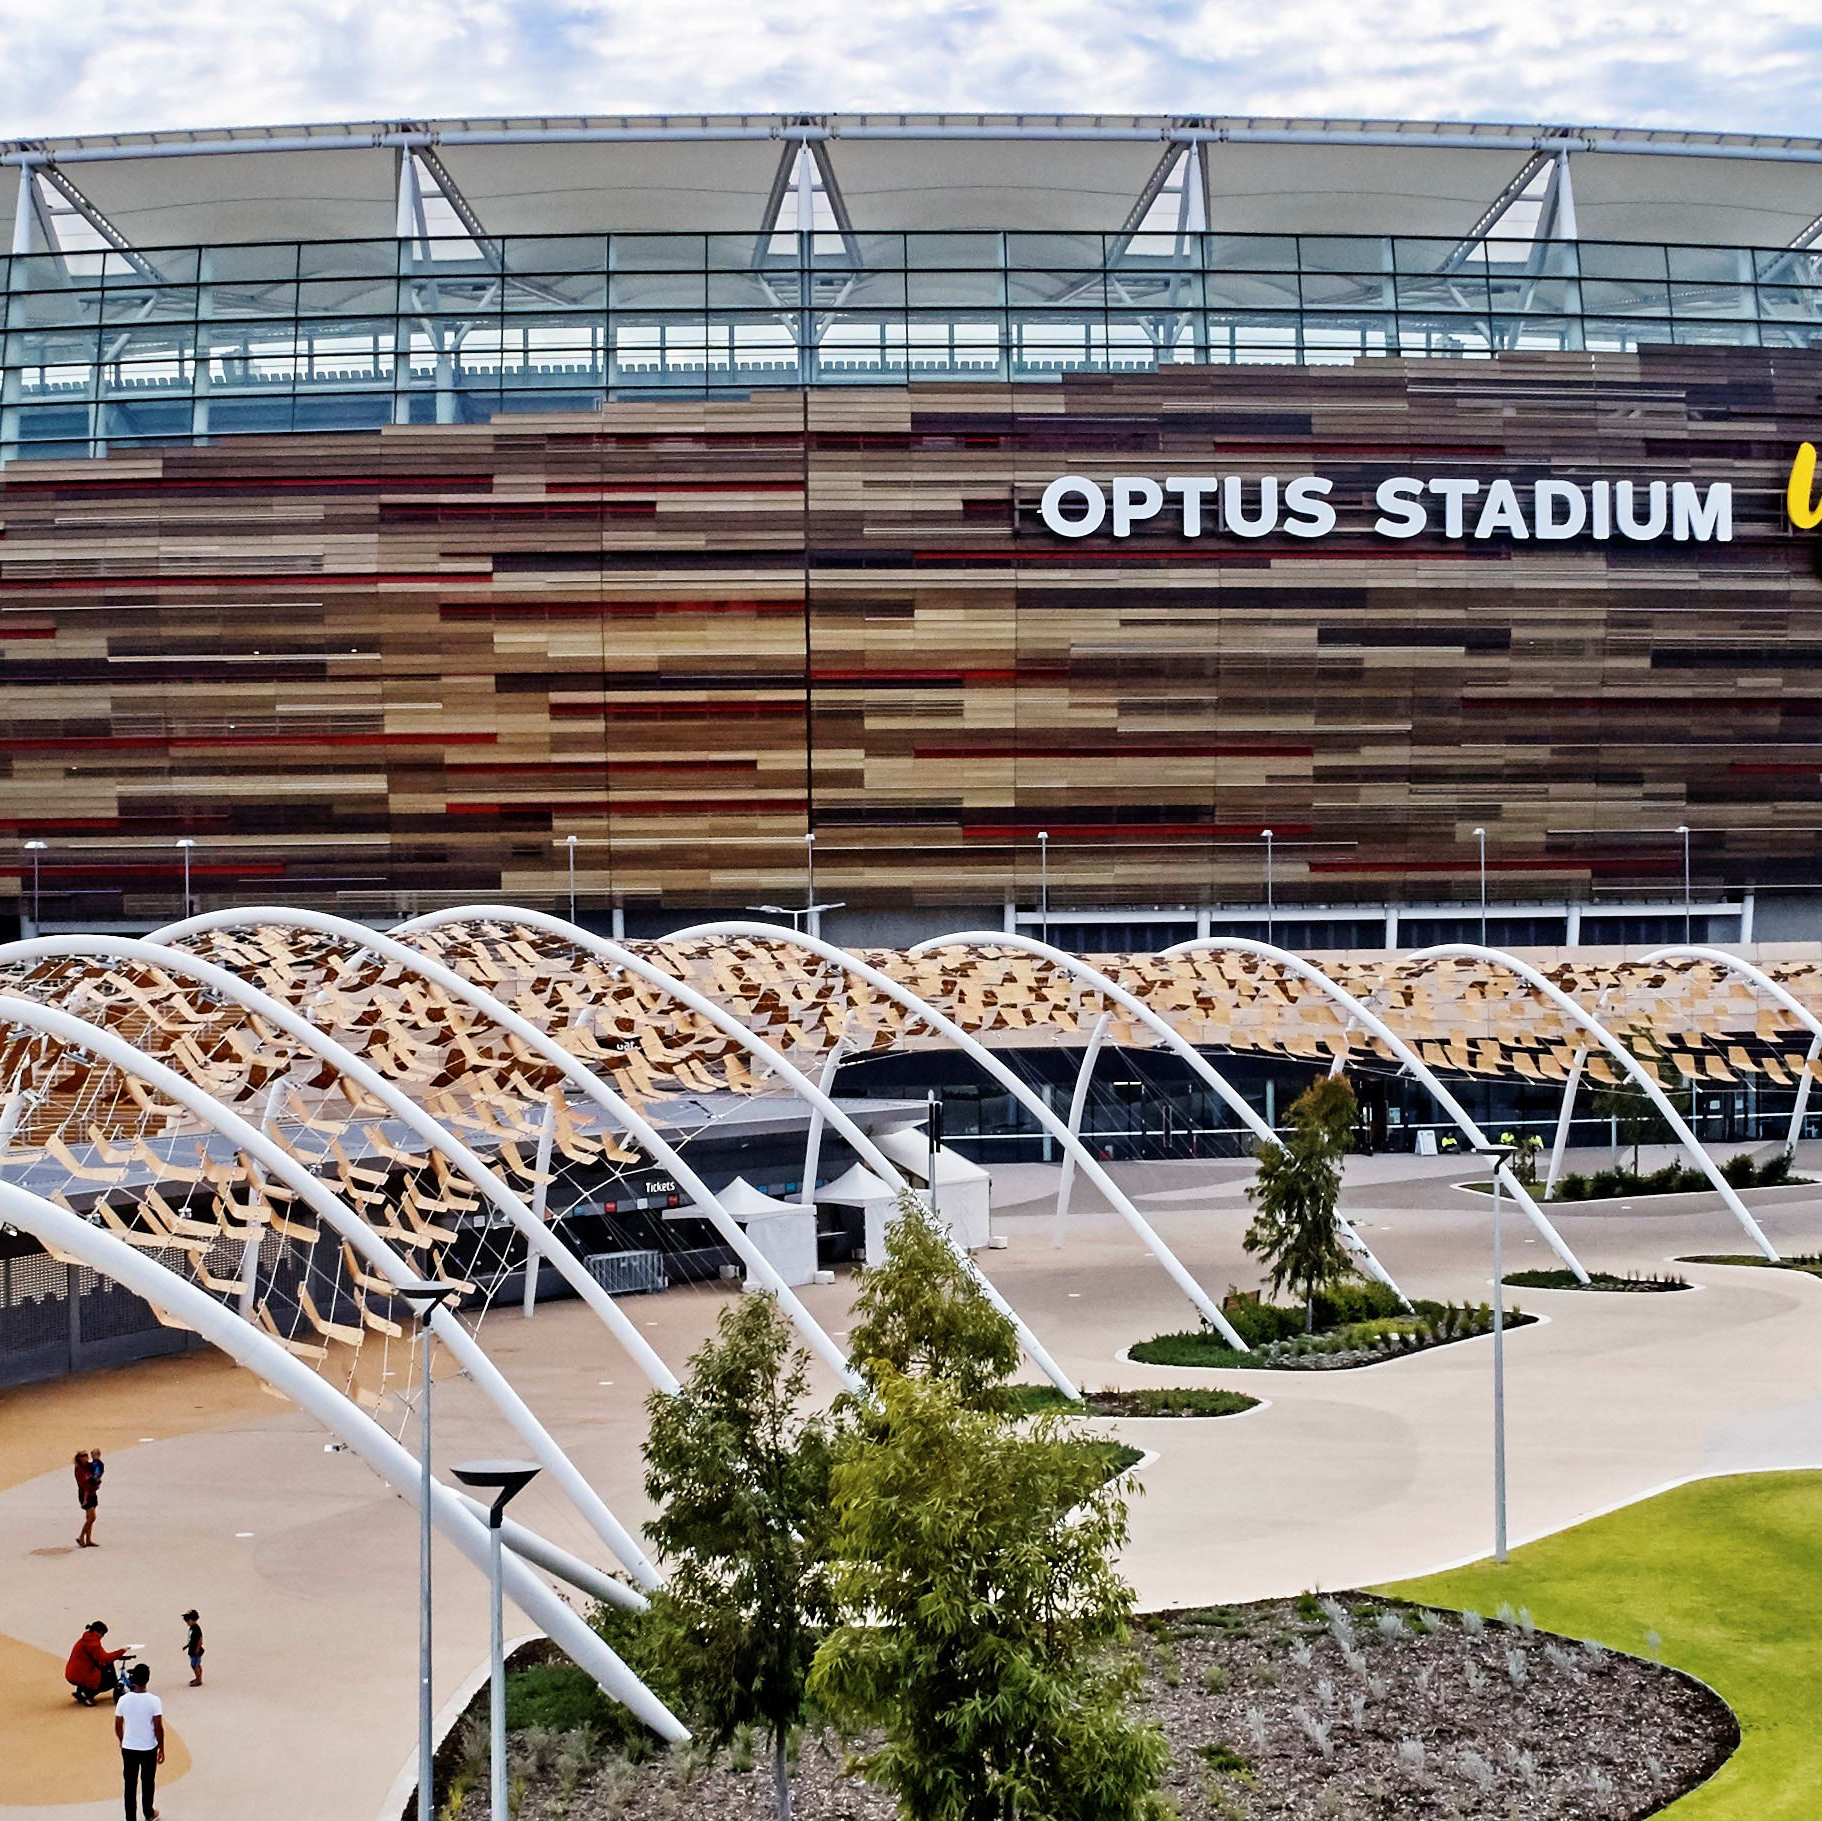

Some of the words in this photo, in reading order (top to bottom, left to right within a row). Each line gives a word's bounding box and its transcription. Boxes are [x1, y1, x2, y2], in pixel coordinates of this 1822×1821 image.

[1041, 475, 1337, 537] OPTUS
[1374, 477, 1733, 542] STADIUM
[646, 1181, 676, 1193] Tickets
